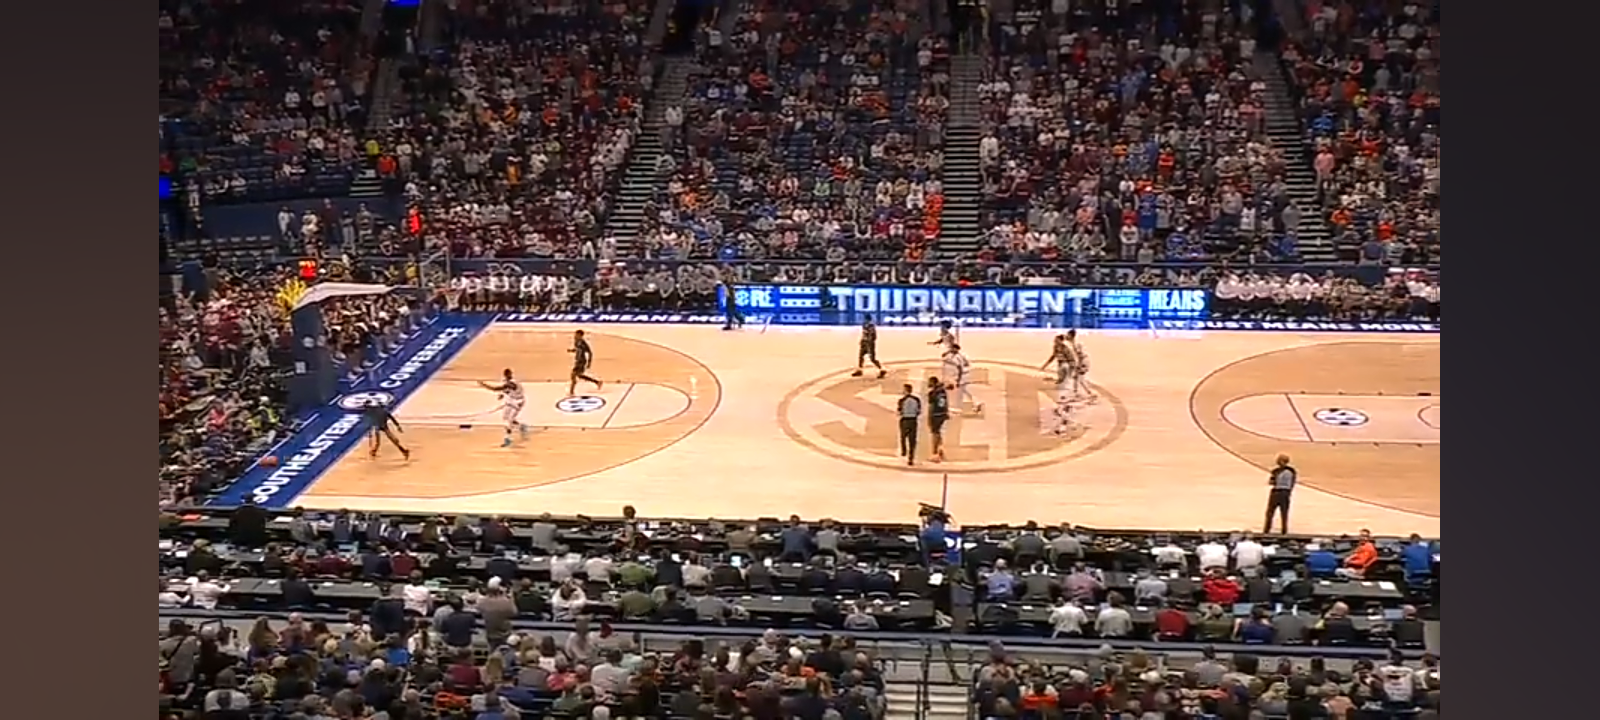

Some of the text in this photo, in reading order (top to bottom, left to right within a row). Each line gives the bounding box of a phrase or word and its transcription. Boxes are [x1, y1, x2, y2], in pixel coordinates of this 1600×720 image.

[828, 287, 1092, 312] TOURNAMENT
[1148, 289, 1206, 311] MEANS
[532, 313, 595, 321] JUST
[597, 314, 682, 322] MEANS
[1260, 321, 1355, 330] MEANS
[252, 327, 467, 504] SOUTHEASTERN CONFERENCE
